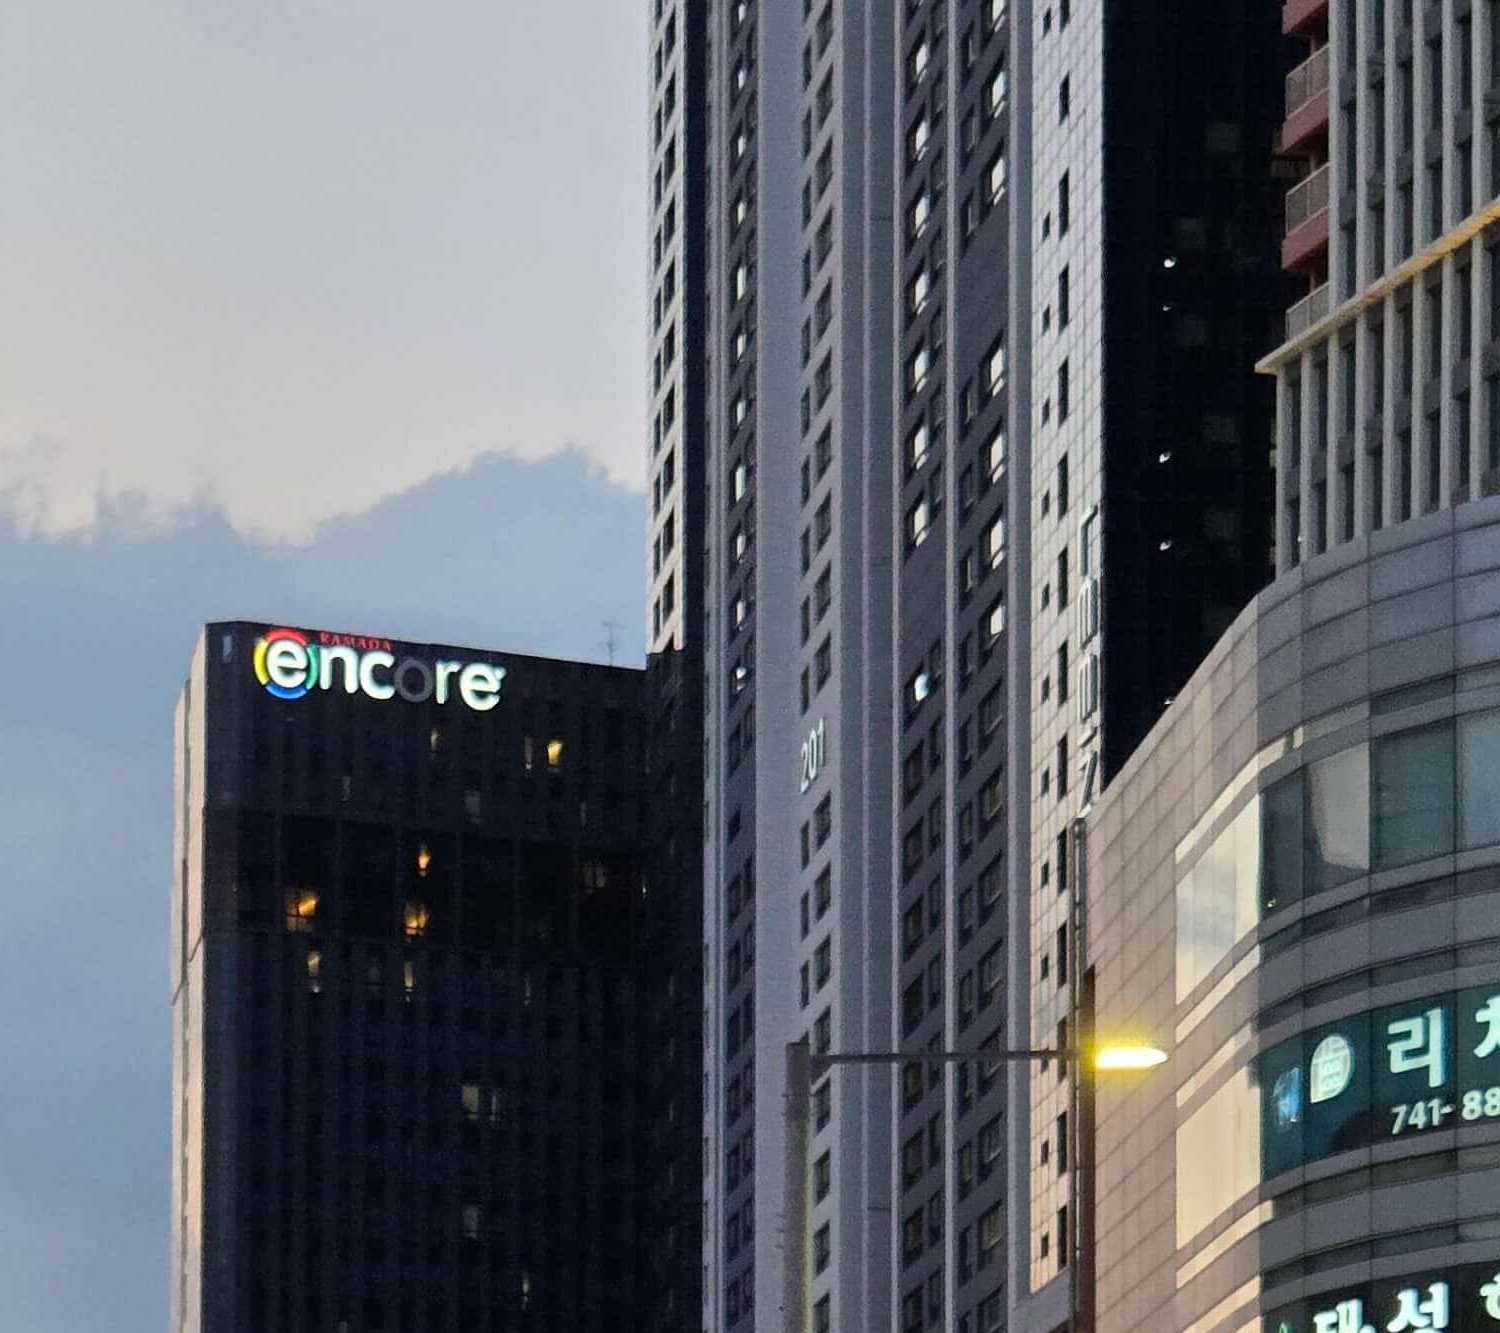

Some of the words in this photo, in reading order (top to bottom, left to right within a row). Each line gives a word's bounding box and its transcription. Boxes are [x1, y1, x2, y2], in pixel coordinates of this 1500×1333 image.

[259, 633, 503, 711] encore
[318, 631, 393, 652] RAMADA
[800, 717, 824, 793] 201
